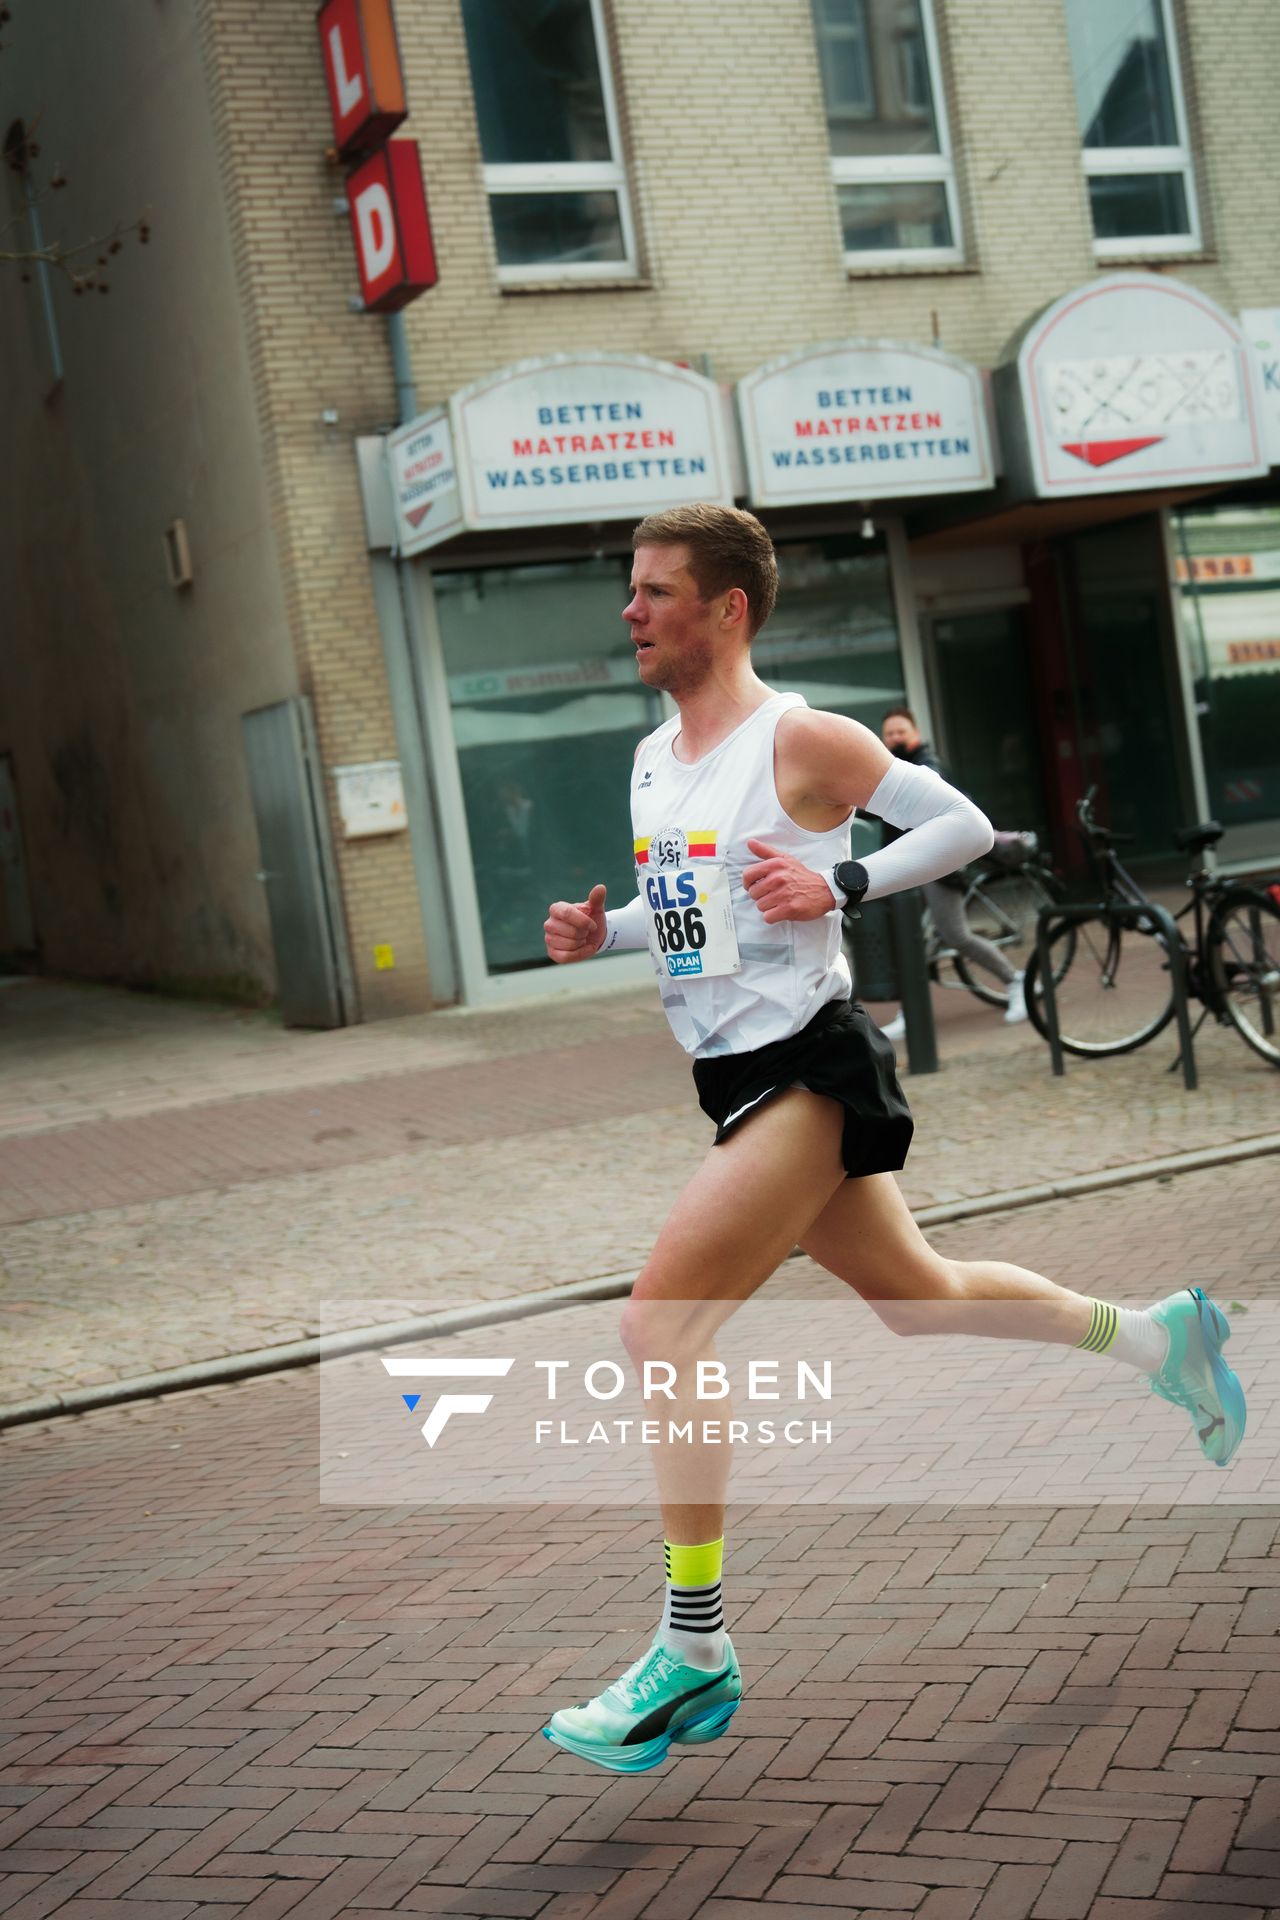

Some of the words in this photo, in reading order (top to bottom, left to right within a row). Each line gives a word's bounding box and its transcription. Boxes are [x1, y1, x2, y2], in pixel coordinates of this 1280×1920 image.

[355, 182, 396, 283] D
[818, 386, 912, 408] BETTEN
[538, 402, 643, 426] BETTEN
[795, 412, 942, 438] MATRATZEN
[513, 431, 676, 457] MATRATZEN
[772, 437, 970, 469] WASSERBETTEN
[487, 458, 706, 488] WASSERBETTEN
[645, 871, 697, 911] GLS
[654, 906, 707, 953] 886
[676, 955, 701, 968] PLAN
